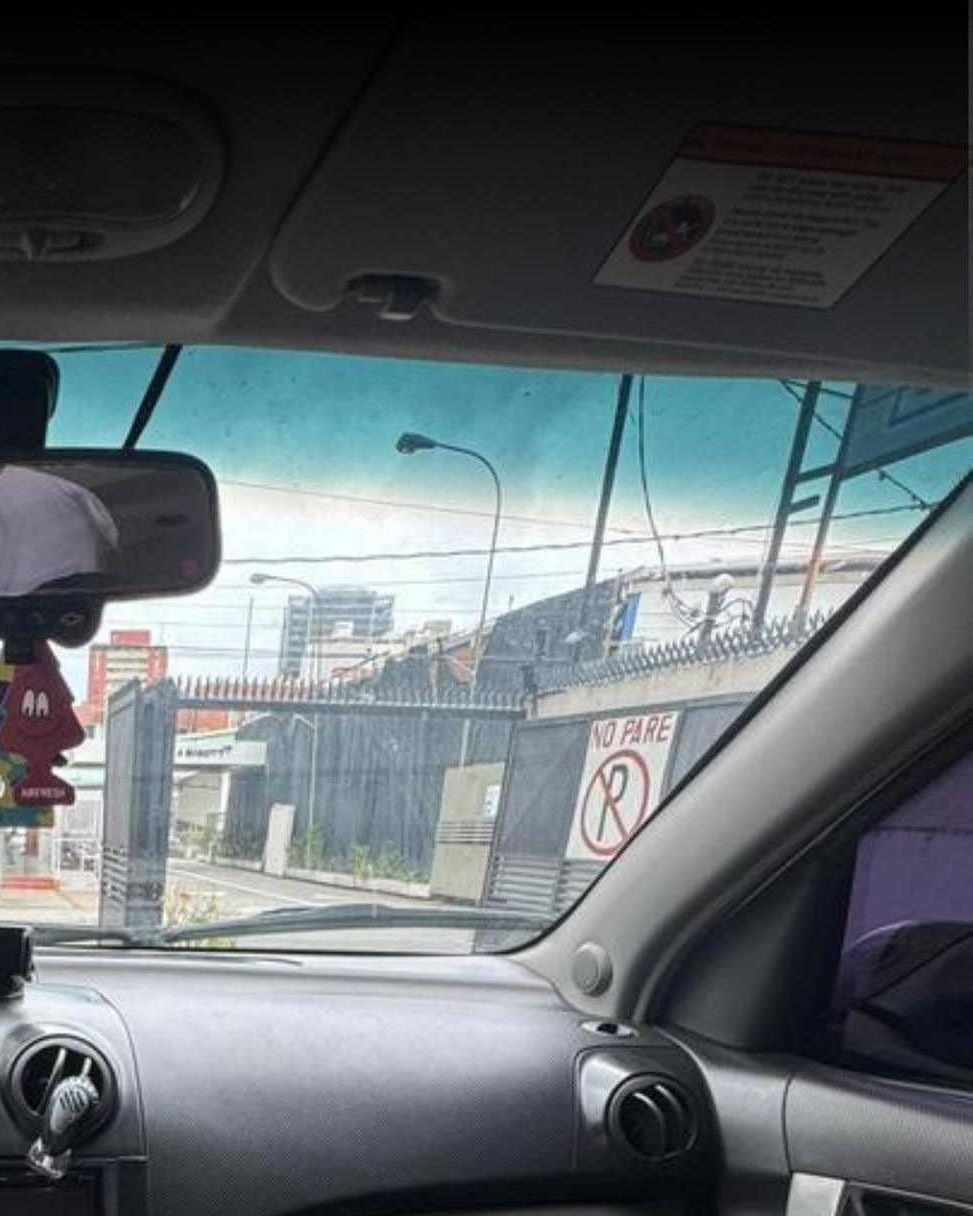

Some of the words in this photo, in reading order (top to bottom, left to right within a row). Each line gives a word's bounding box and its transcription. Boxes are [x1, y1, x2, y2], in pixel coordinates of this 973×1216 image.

[591, 720, 616, 748] NO
[621, 715, 672, 743] PARE
[598, 764, 630, 842] P
